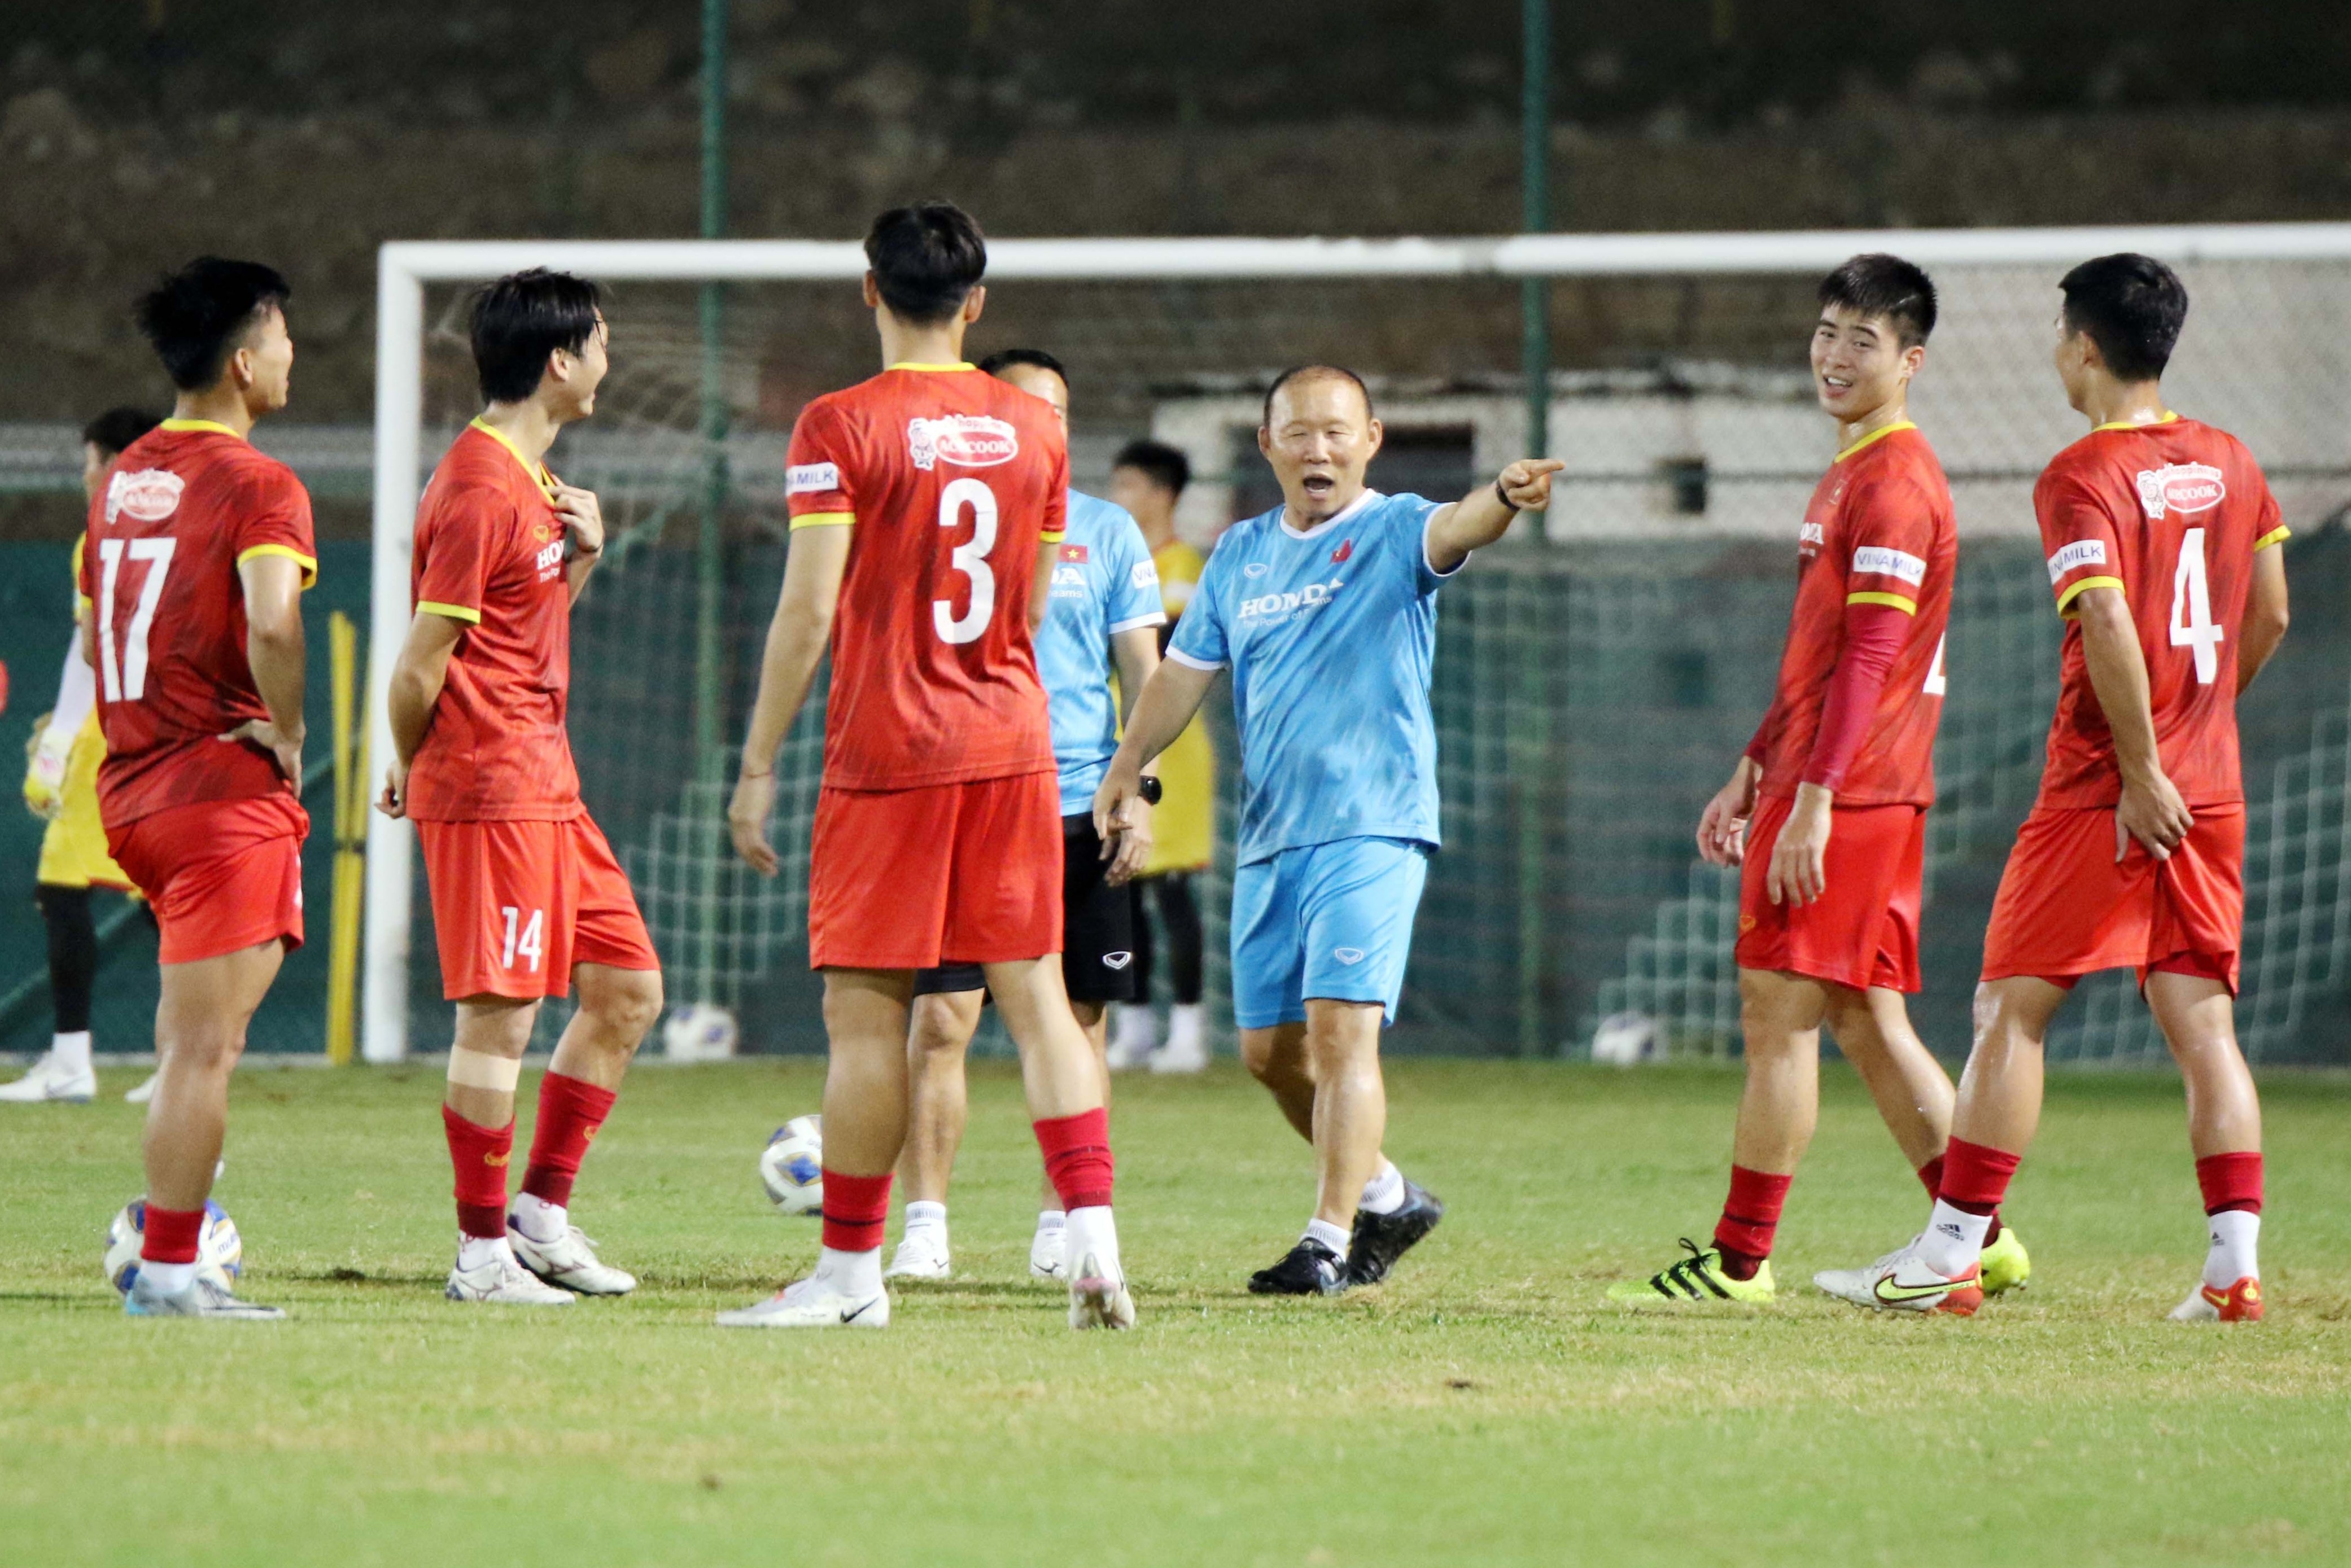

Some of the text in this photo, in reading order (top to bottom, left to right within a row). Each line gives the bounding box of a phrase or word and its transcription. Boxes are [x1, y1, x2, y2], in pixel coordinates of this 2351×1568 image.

[99, 537, 177, 702] 17
[537, 540, 565, 570] HO
[933, 478, 998, 644] 3
[2170, 527, 2223, 684] 4
[502, 906, 543, 973] 14
